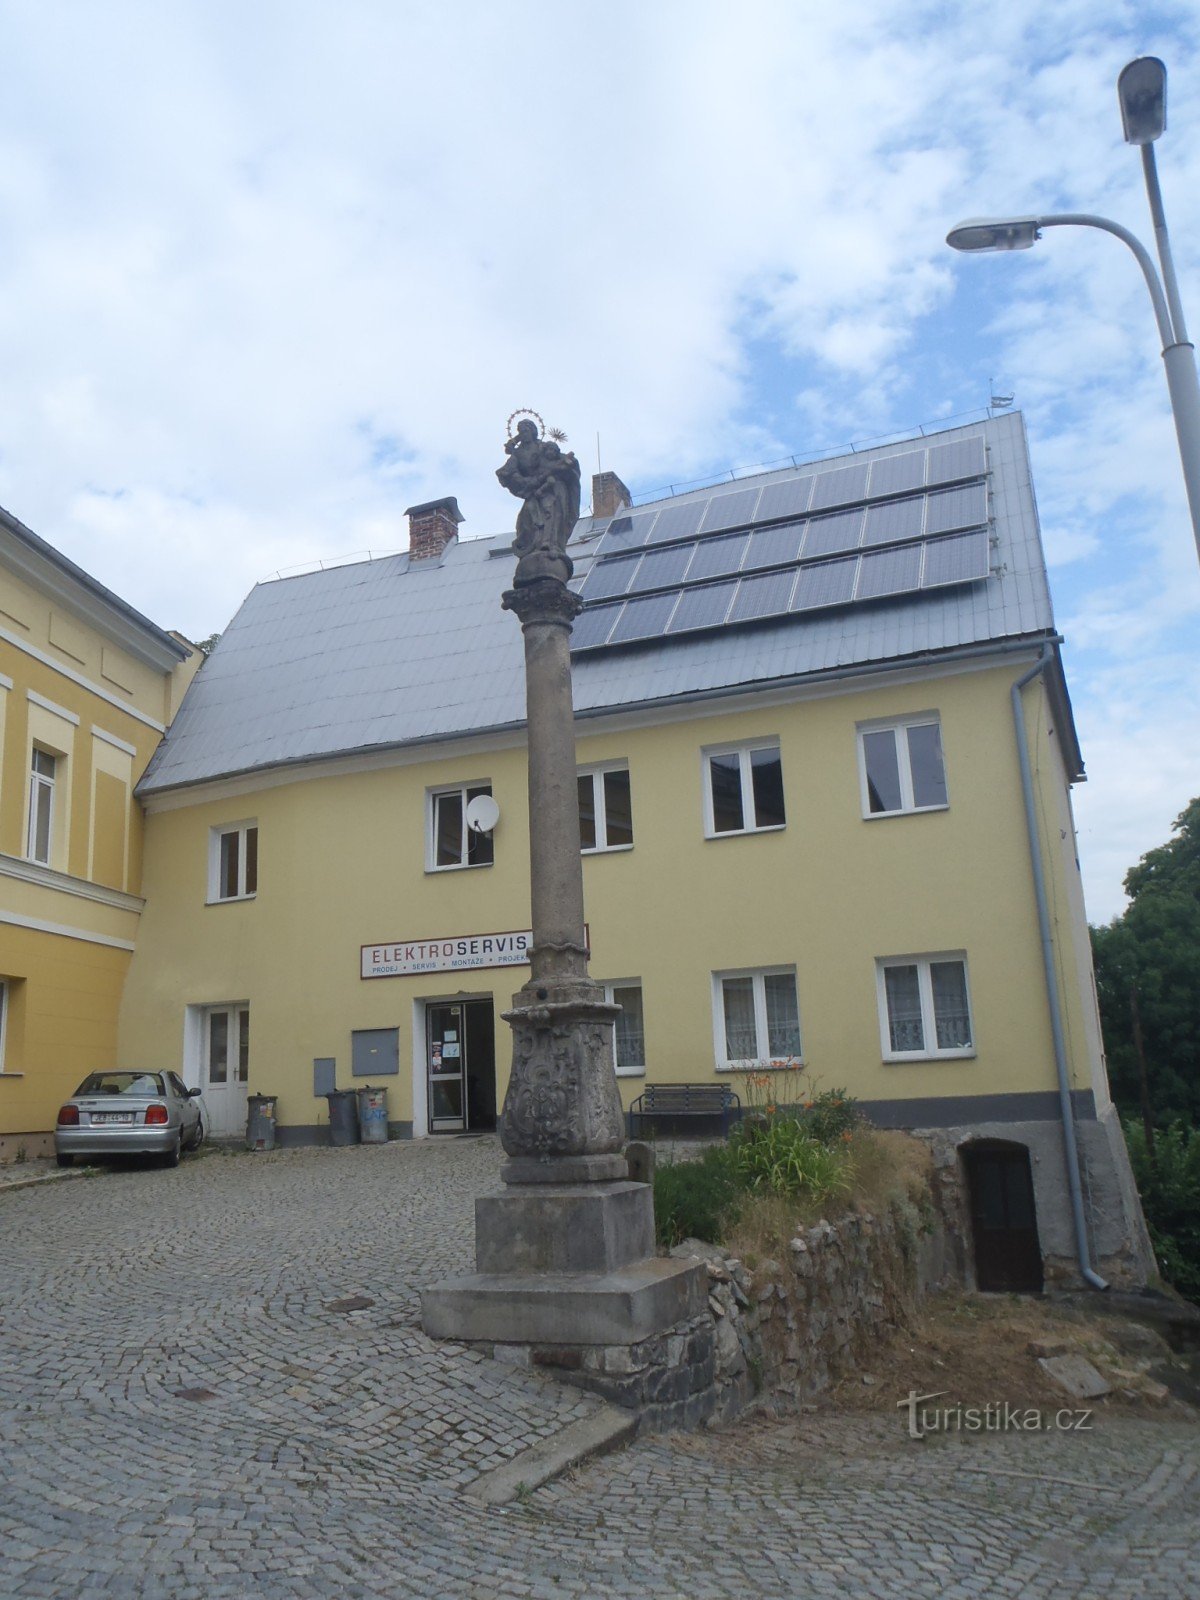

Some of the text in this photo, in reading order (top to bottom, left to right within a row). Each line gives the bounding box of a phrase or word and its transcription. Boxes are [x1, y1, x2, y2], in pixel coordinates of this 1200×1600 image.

[372, 936, 527, 964] ELEKTROSERVIS
[372, 954, 529, 974] PRODEJ SERVIS MONTAŽE PROJEK
